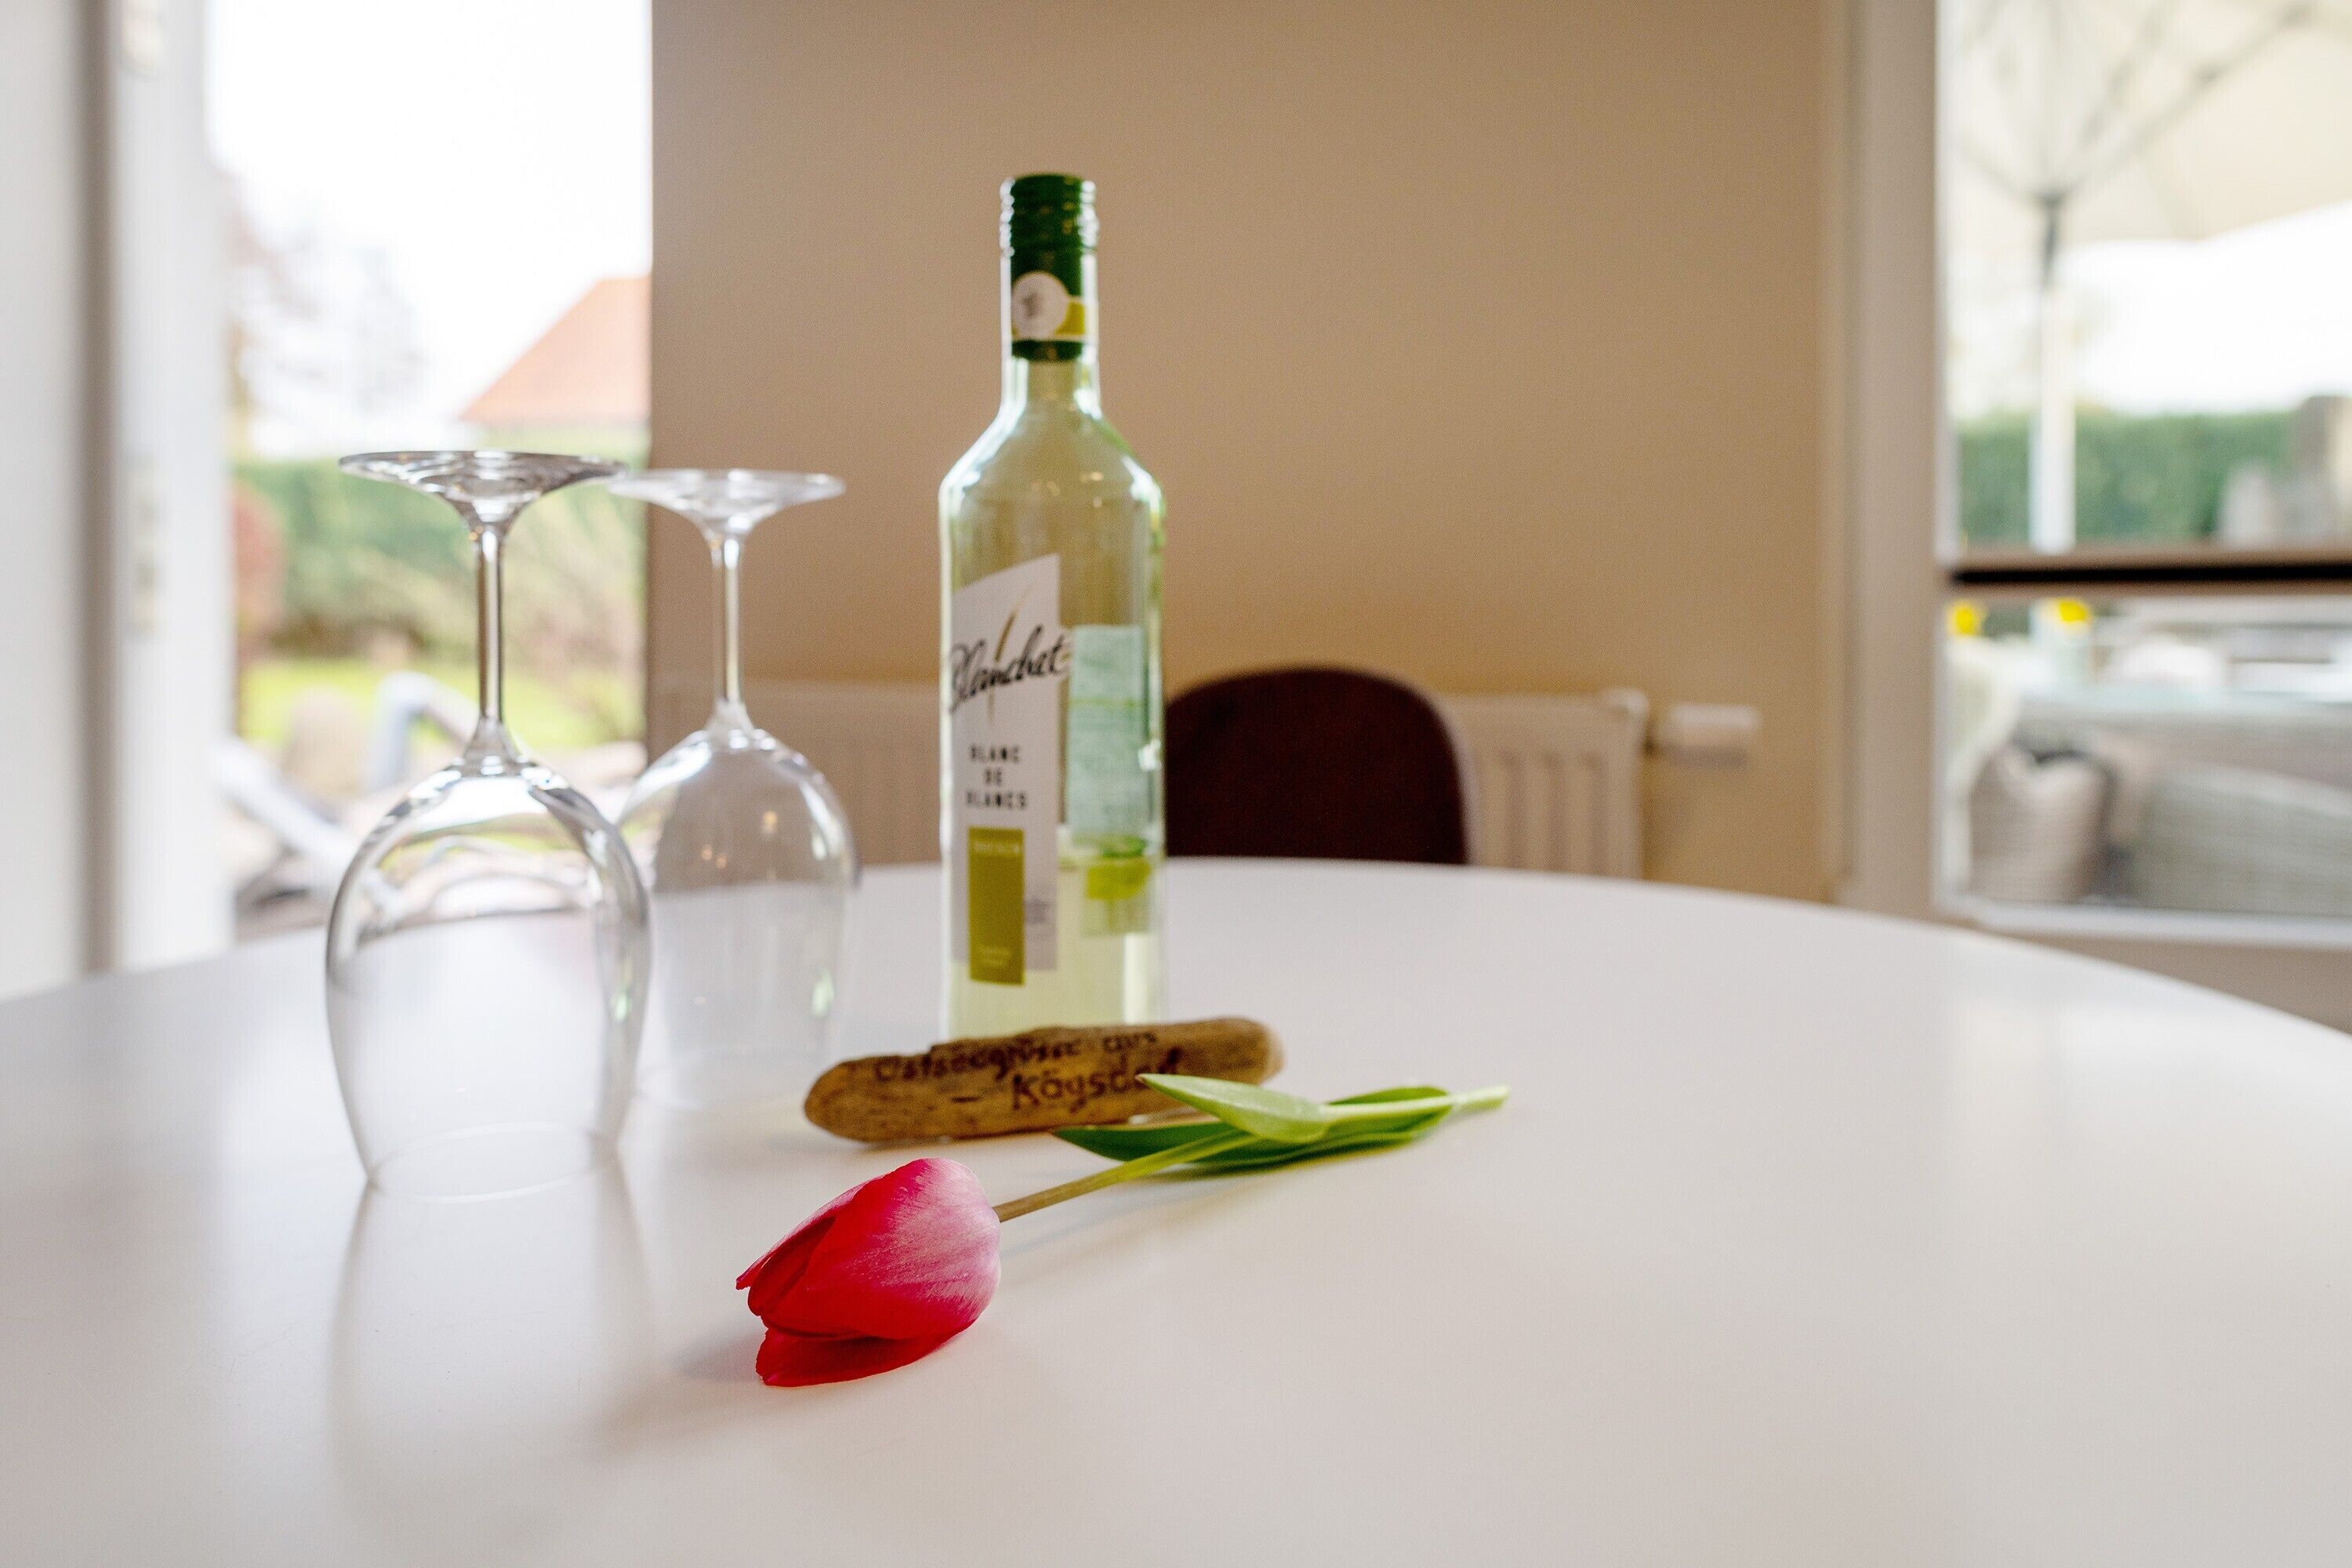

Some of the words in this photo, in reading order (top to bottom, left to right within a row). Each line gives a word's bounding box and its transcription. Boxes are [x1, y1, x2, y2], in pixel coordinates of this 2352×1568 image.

[969, 744, 1019, 764] BLANC
[983, 767, 1003, 786] DE
[1102, 1032, 1158, 1053] aus
